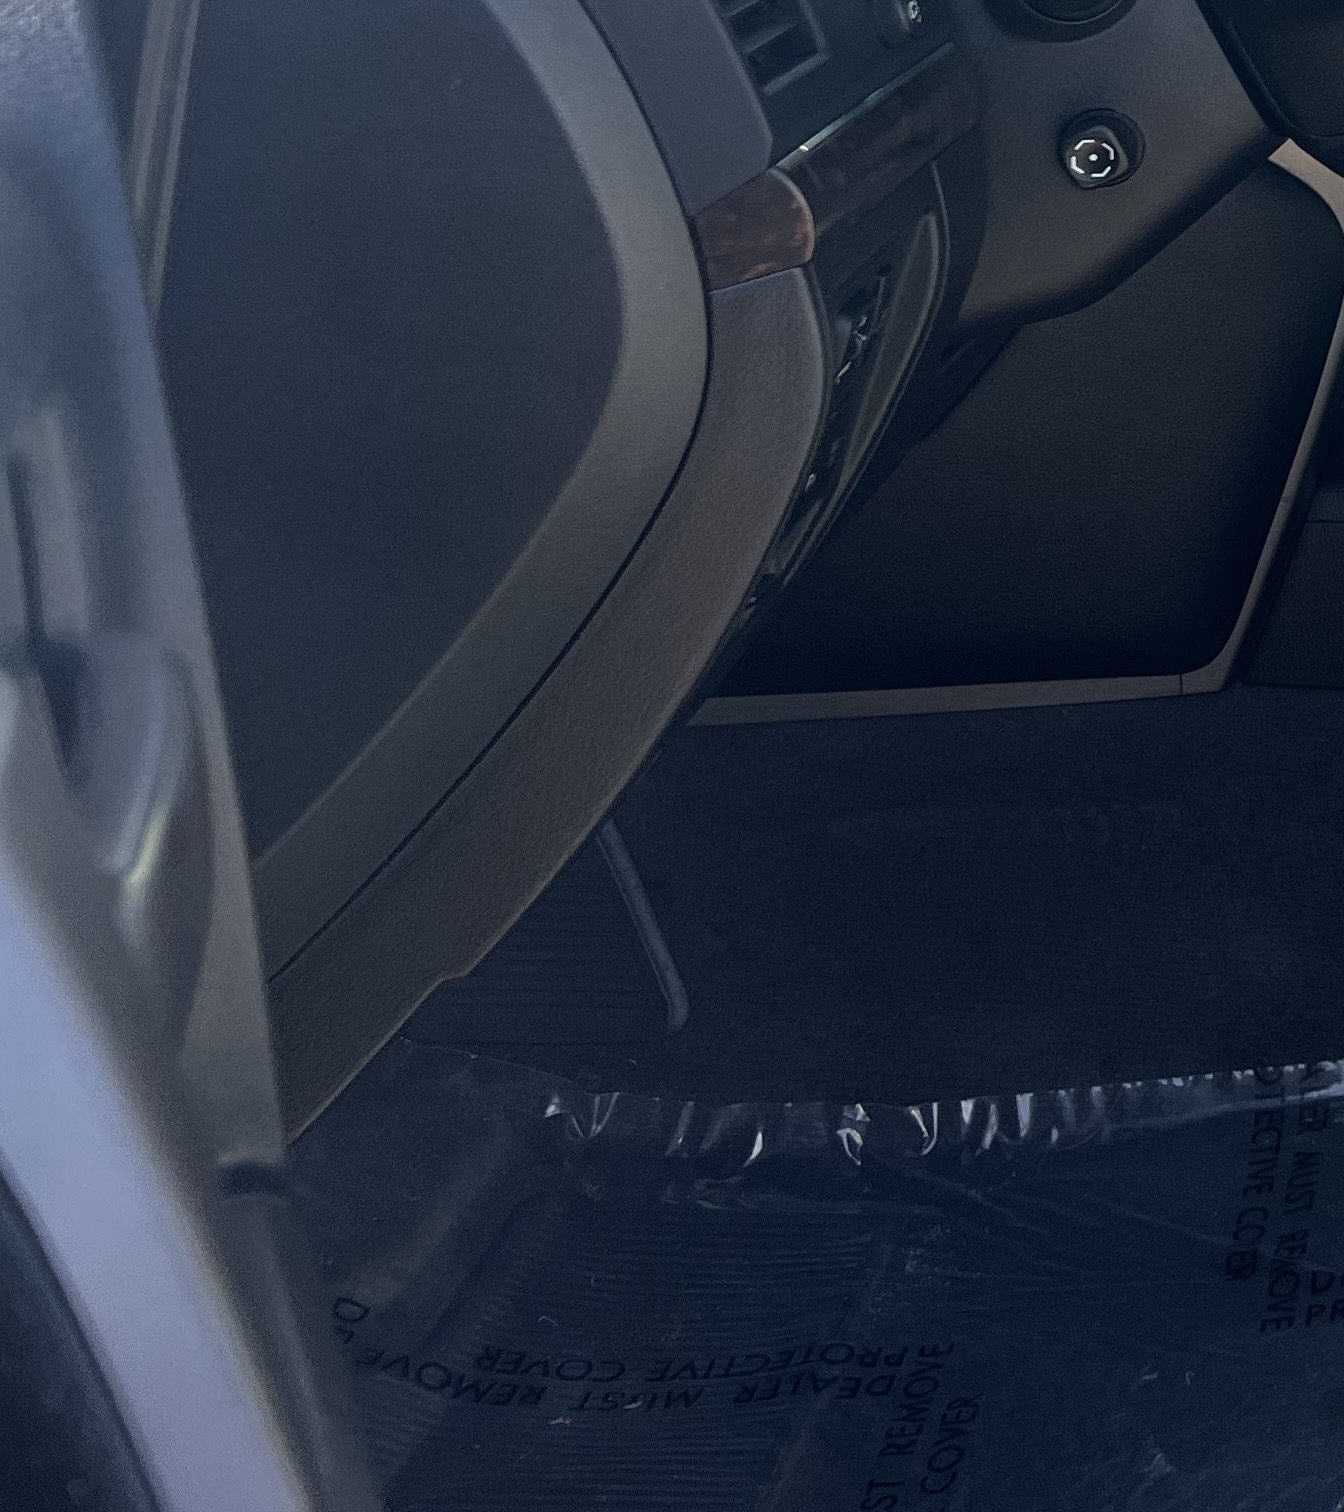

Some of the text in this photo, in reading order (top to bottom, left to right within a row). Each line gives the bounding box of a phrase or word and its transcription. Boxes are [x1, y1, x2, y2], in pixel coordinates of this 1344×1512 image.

[473, 1342, 907, 1383] PROTECTIVE COVER
[920, 1391, 984, 1496] COVER
